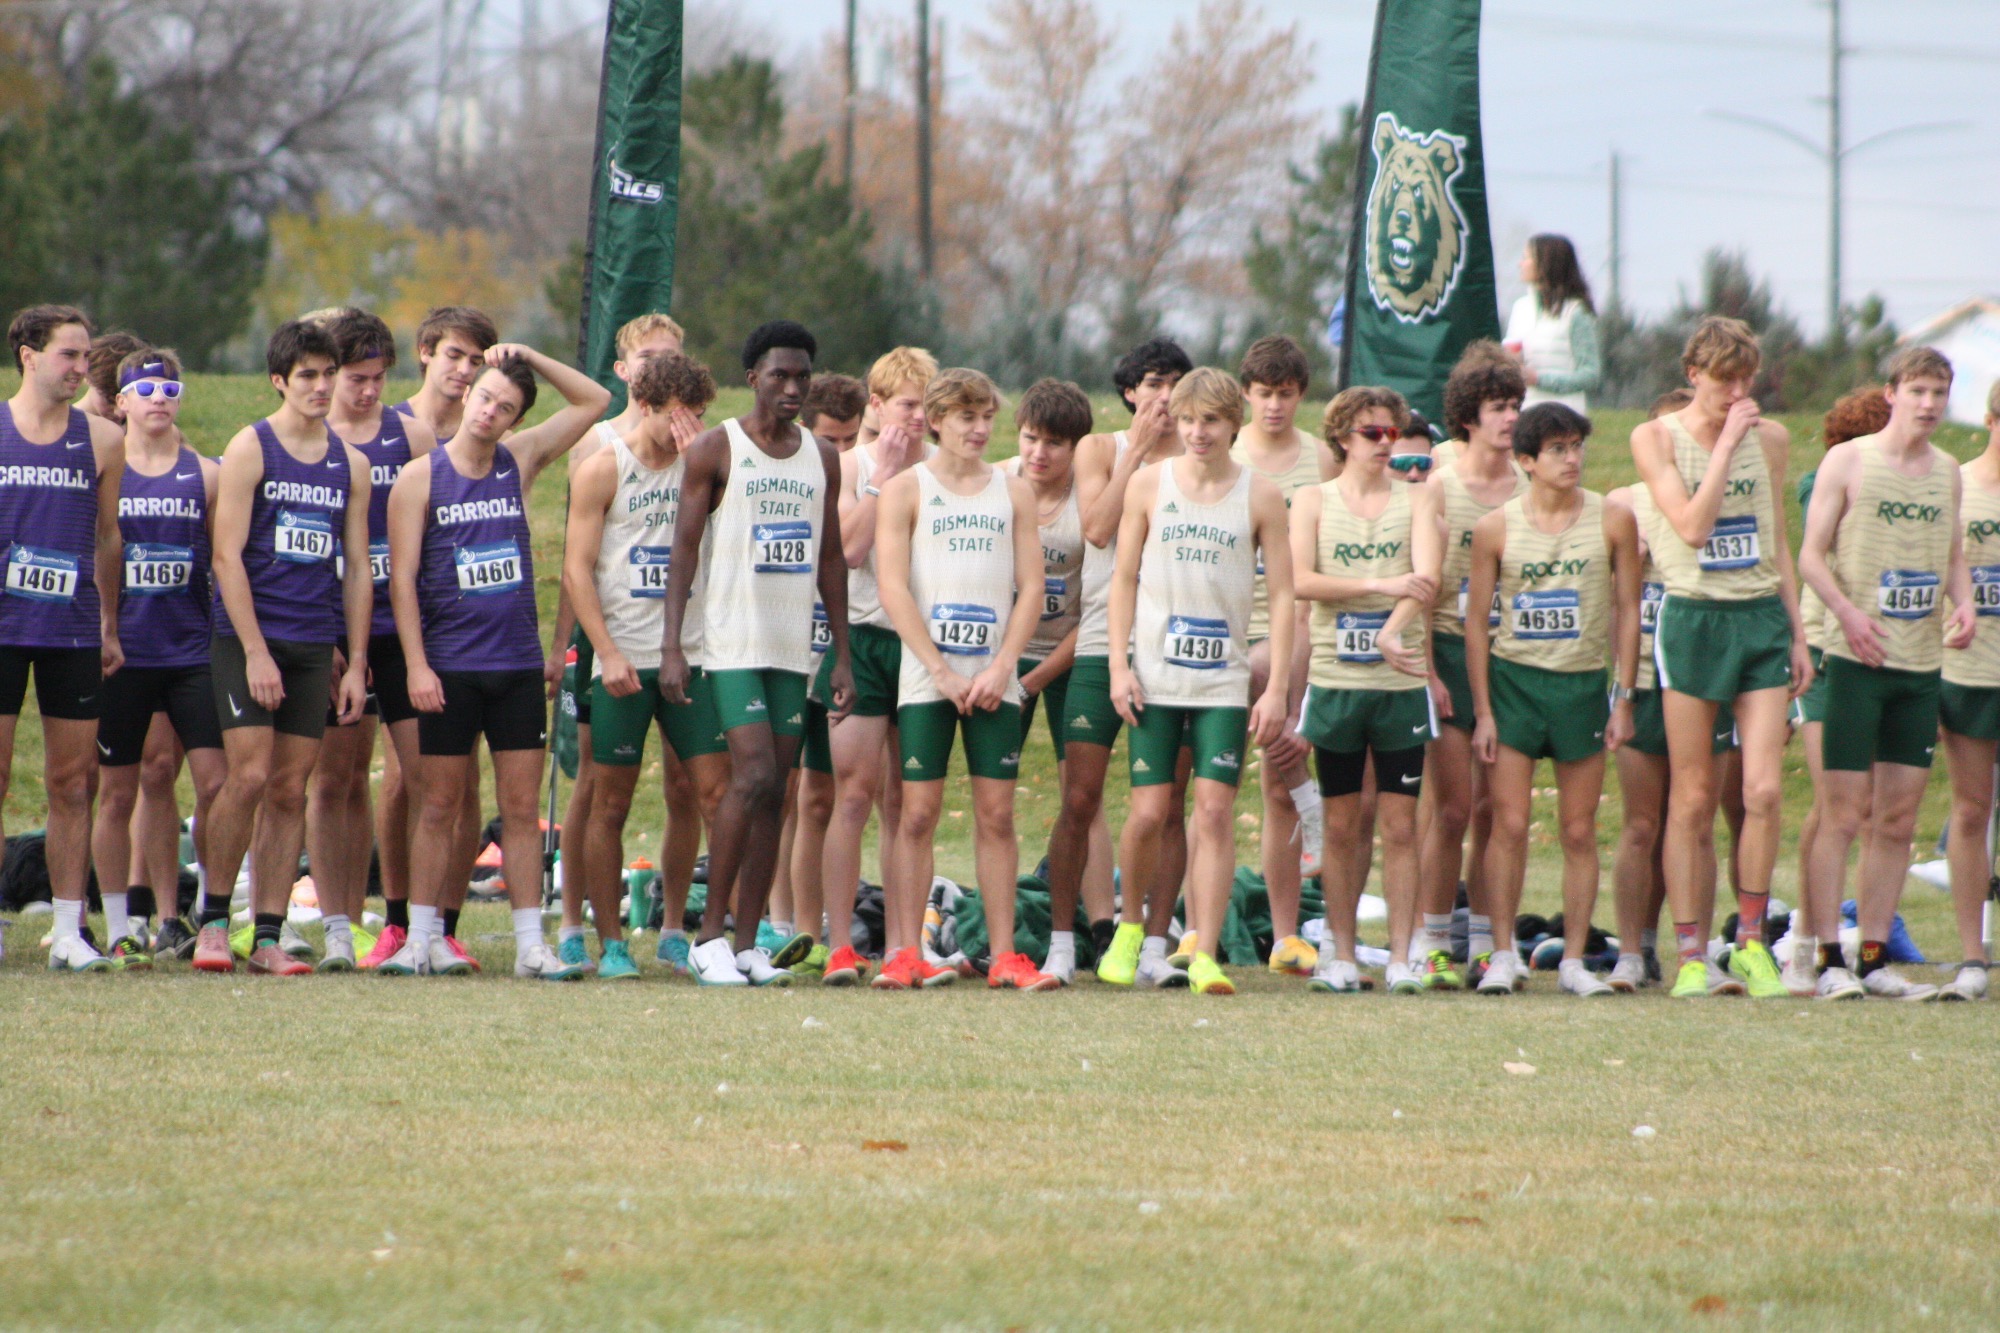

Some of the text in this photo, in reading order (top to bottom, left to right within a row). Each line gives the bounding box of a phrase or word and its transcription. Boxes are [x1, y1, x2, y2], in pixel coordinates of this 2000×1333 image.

[264, 480, 344, 508] CARROLL
[629, 488, 679, 512] BISMAR
[745, 477, 815, 500] BISMARCK
[118, 498, 201, 518] ARROLL
[436, 497, 521, 525] CARROLL
[645, 511, 675, 527] STAT
[759, 500, 801, 517] STATE
[1878, 501, 1941, 525] ROCKY
[933, 515, 1005, 536] BISMARCK
[1161, 524, 1237, 549] BISMARCK
[285, 529, 328, 555] 1467
[763, 541, 805, 563] 1428
[949, 537, 993, 551] STATE
[1705, 536, 1752, 559] 4637
[1175, 547, 1220, 564] STATE
[1333, 541, 1402, 567] ROCKY
[17, 566, 67, 593] 1461
[132, 563, 185, 585] 1469
[465, 559, 515, 586] 1460
[639, 566, 669, 587] 14
[1520, 559, 1590, 584] ROCKY
[1886, 588, 1934, 609] 4644
[1518, 608, 1574, 630] 4635
[938, 621, 988, 645] 1429
[1344, 631, 1379, 652] 46
[1173, 637, 1223, 660] 1430
